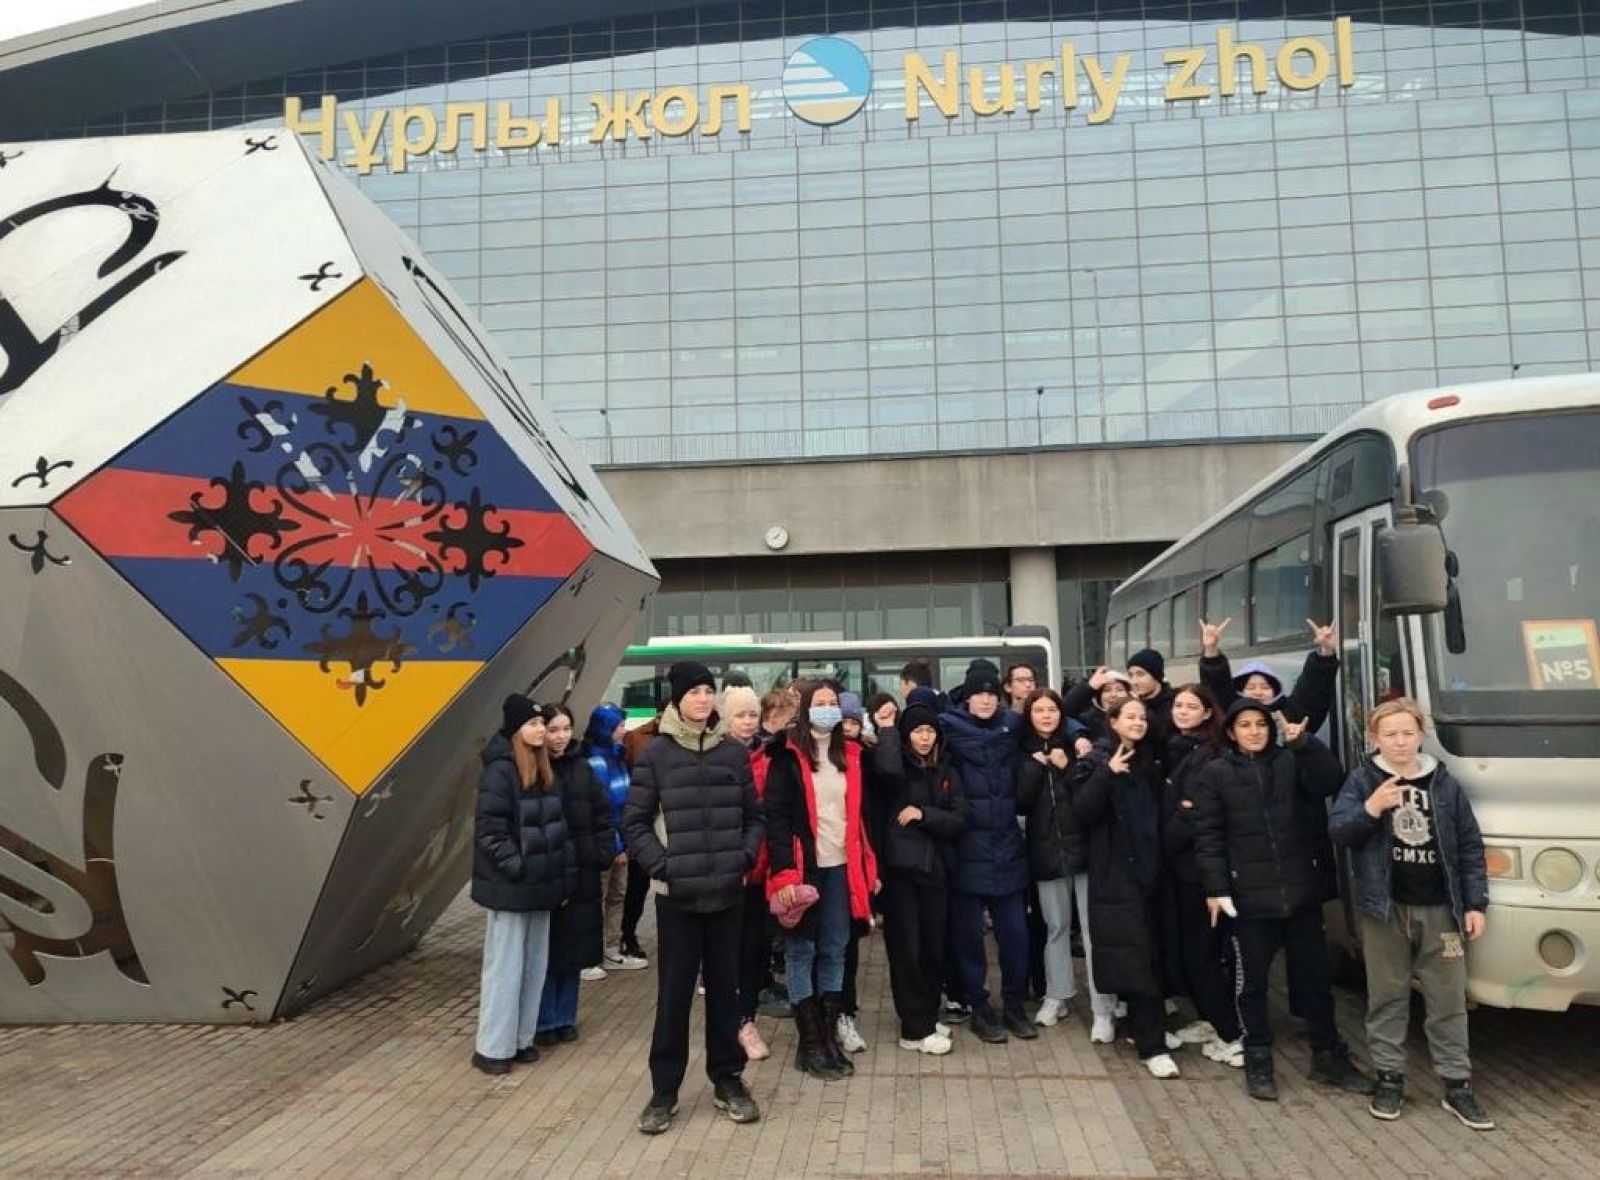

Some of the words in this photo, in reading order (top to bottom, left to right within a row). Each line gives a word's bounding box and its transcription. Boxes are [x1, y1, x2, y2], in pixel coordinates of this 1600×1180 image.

[904, 42, 1130, 124] Nurly
[1163, 16, 1355, 101] zhol
[284, 94, 560, 173] Нұрлы
[588, 84, 752, 143] жол
